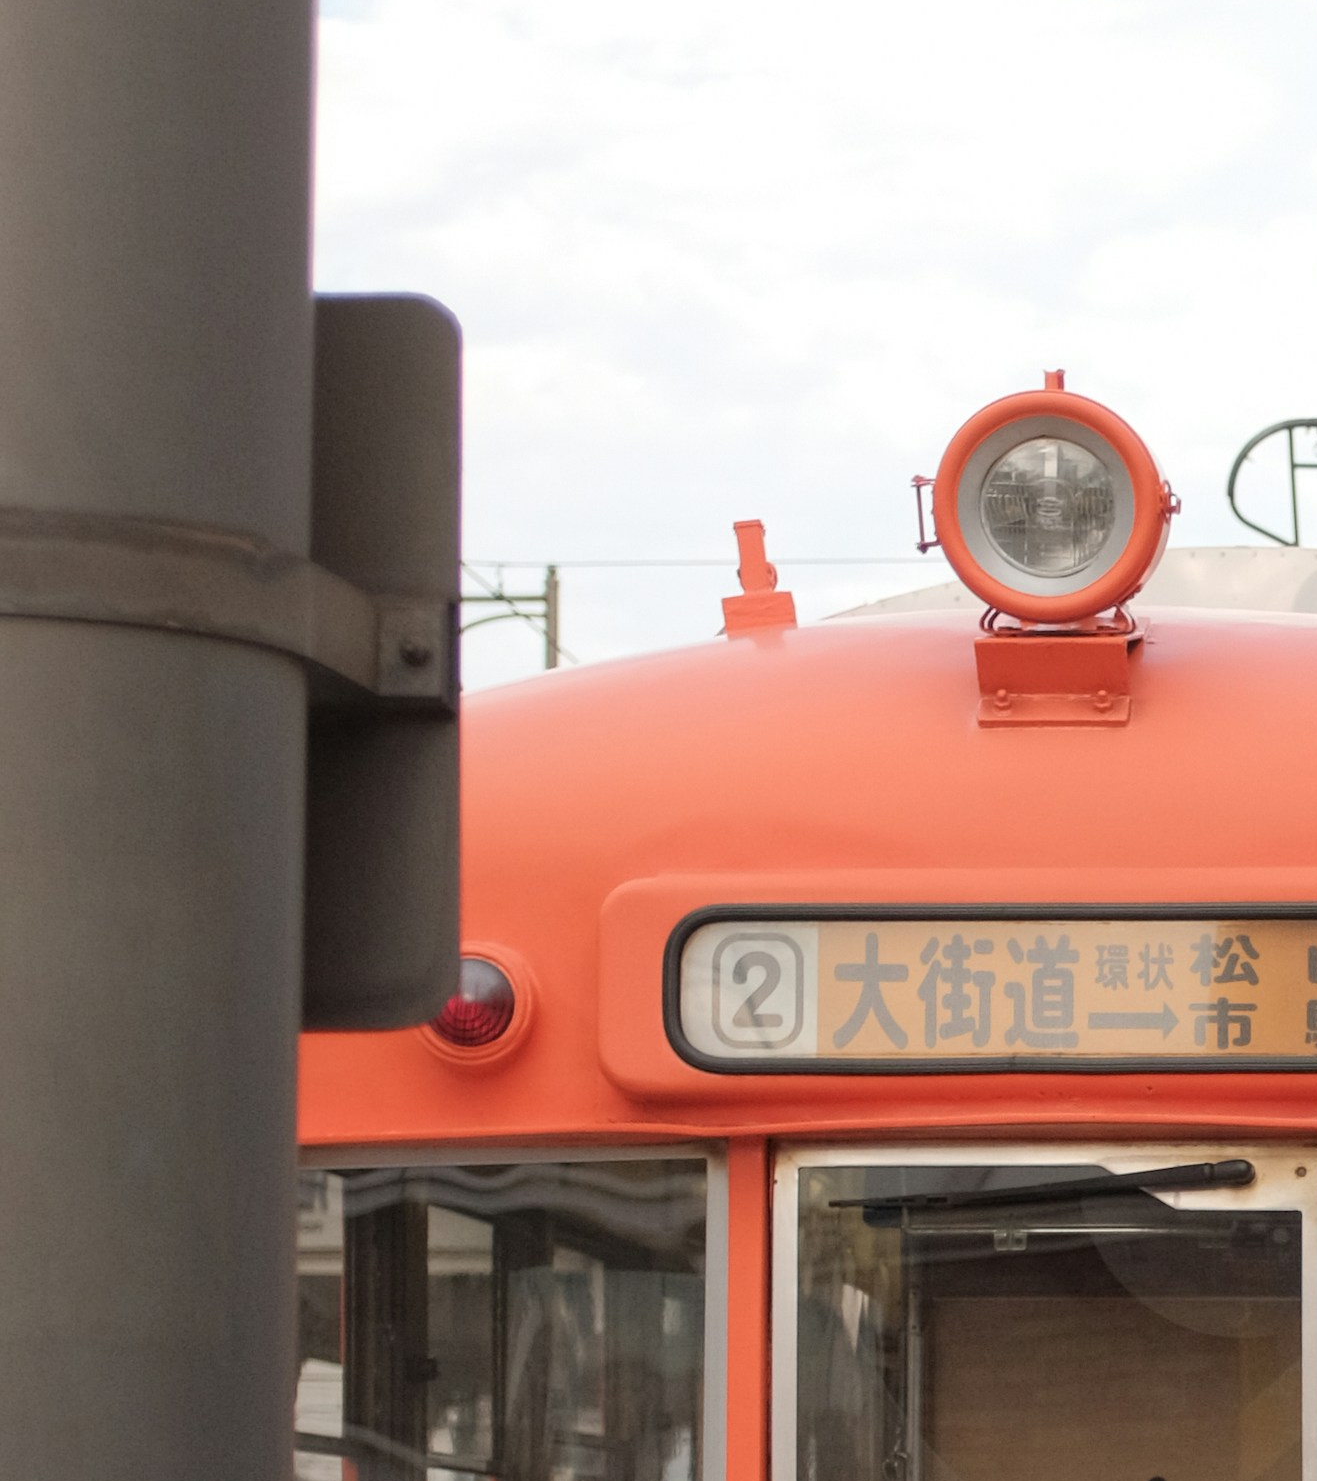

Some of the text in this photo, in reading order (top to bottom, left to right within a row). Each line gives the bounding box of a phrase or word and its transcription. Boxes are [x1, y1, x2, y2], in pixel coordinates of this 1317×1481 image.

[731, 932, 1177, 1051] 2 大街道 環状
